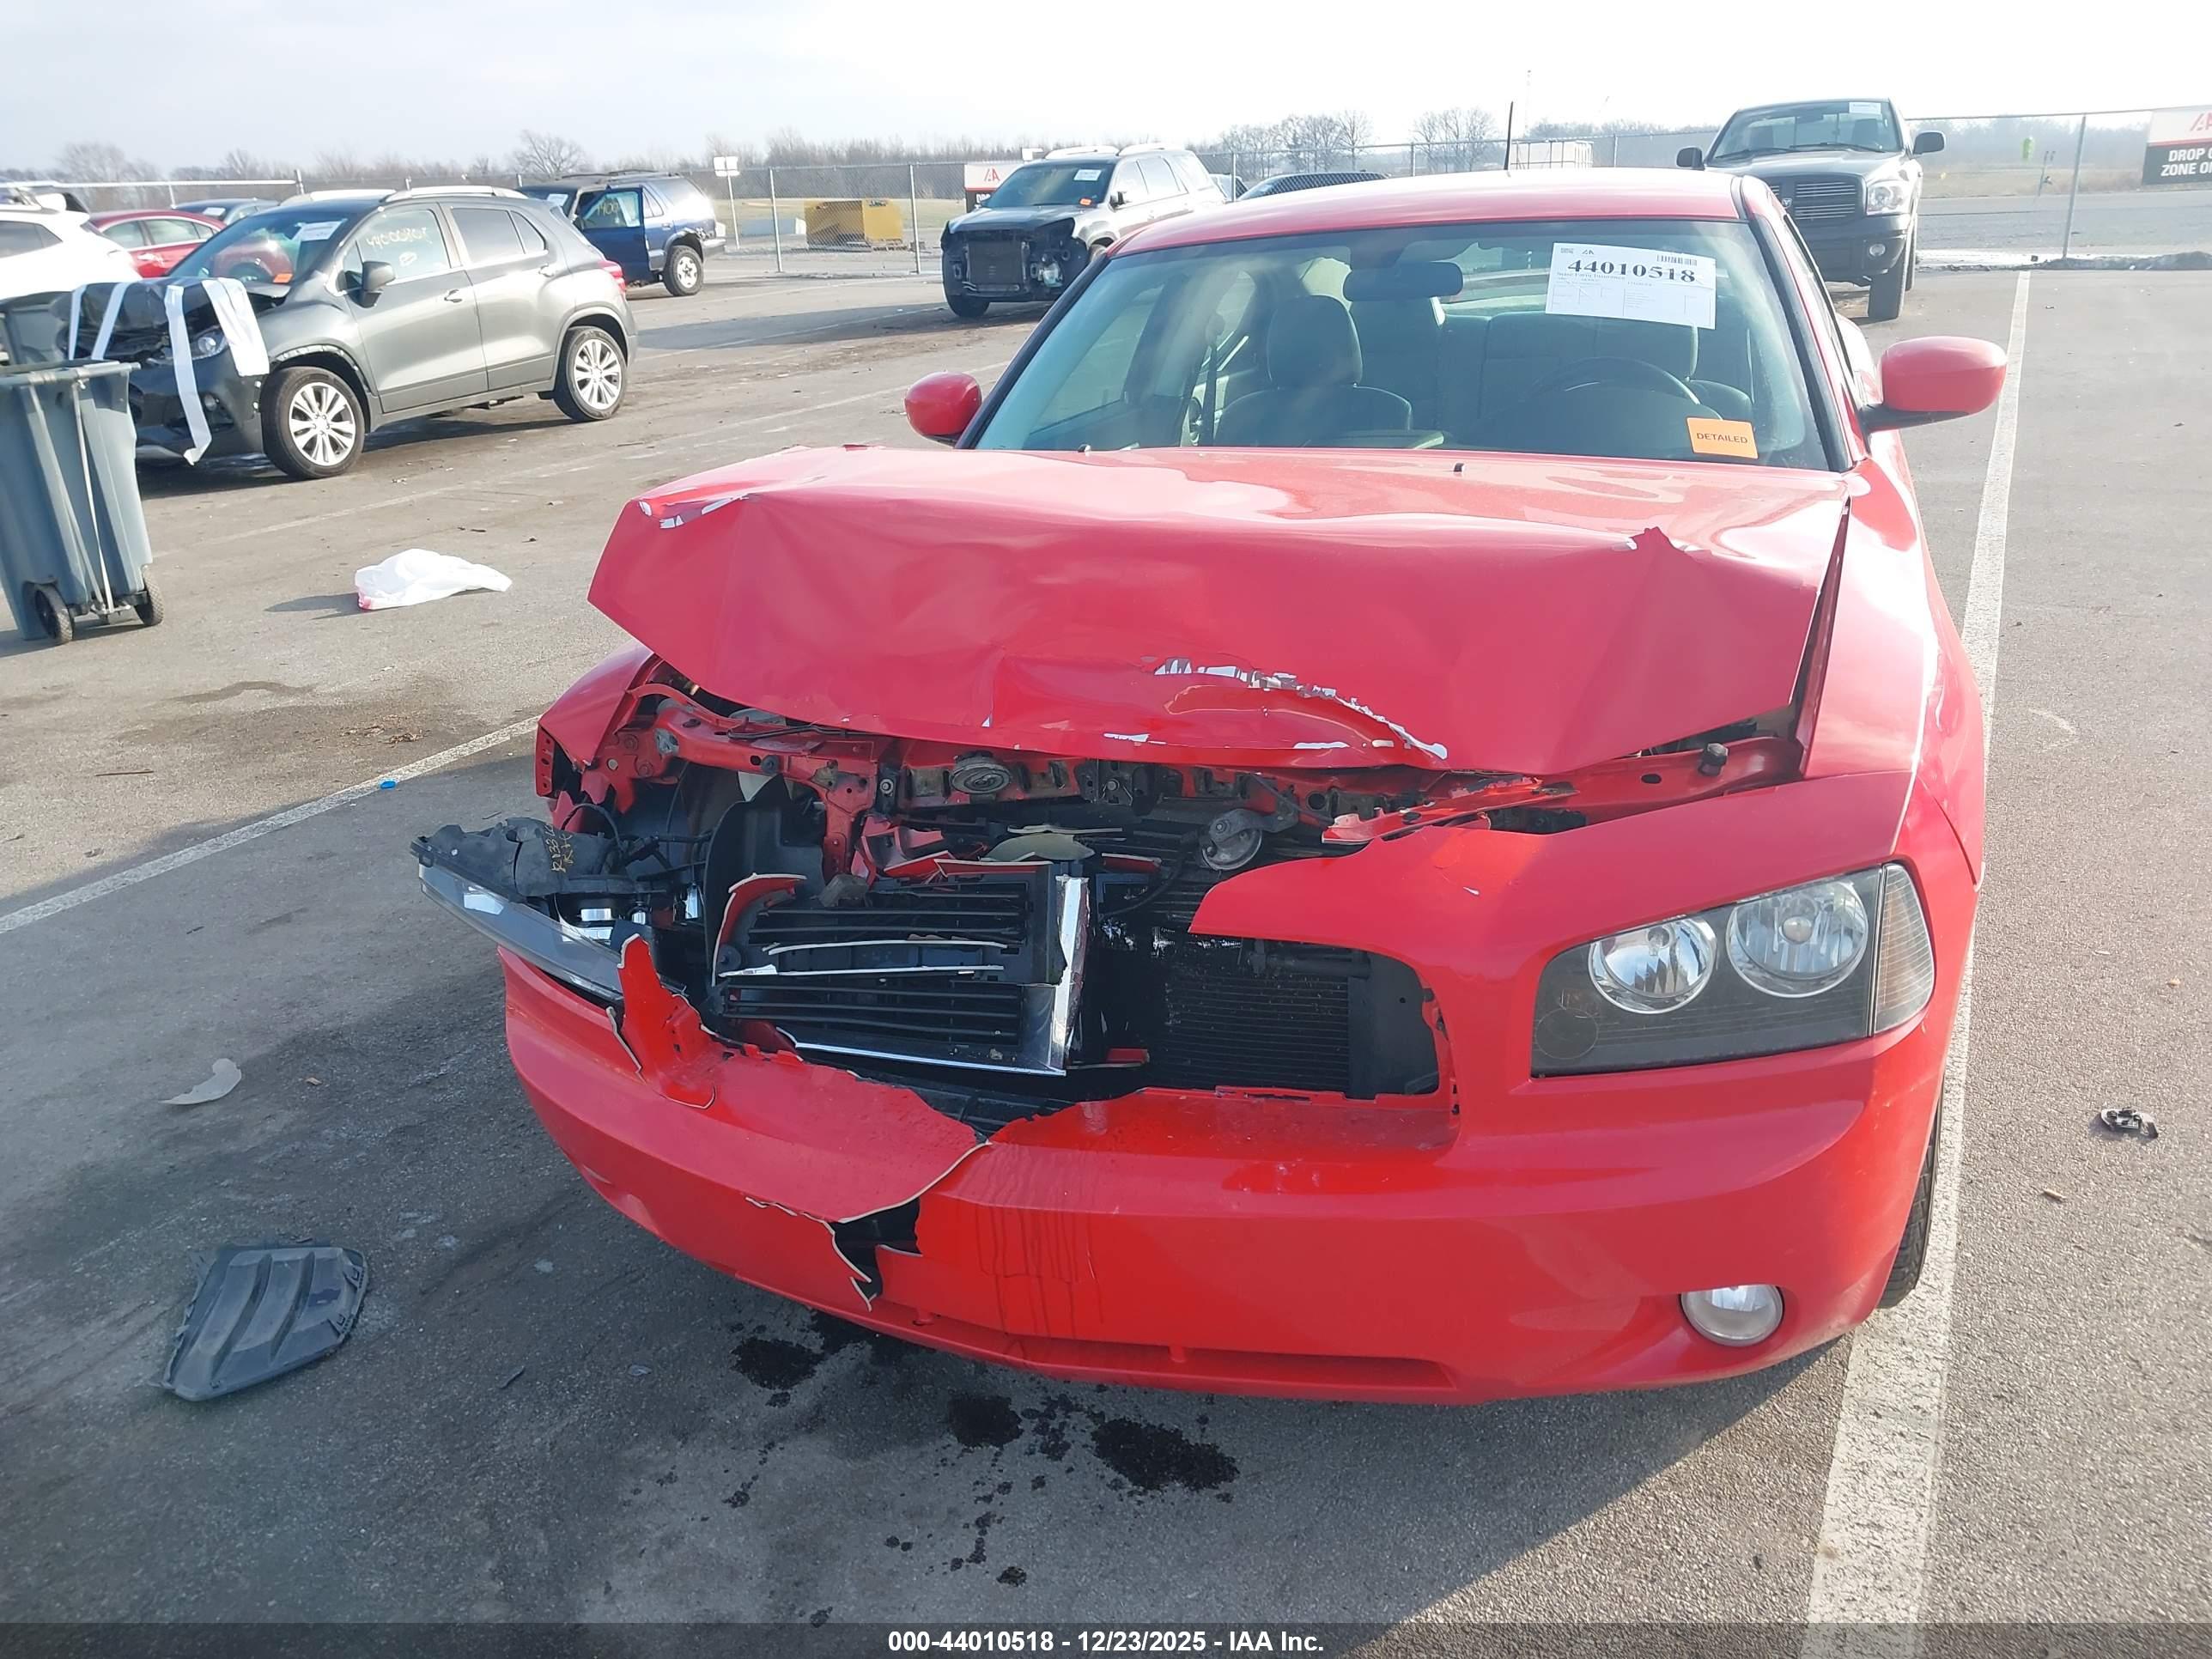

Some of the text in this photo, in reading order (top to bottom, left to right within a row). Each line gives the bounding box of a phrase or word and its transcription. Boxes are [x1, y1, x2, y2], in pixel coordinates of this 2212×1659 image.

[2168, 148, 2206, 161] DROP
[2160, 162, 2197, 177] ZONE
[1567, 259, 1696, 283] 44010518
[1696, 433, 1748, 444] DETAILED
